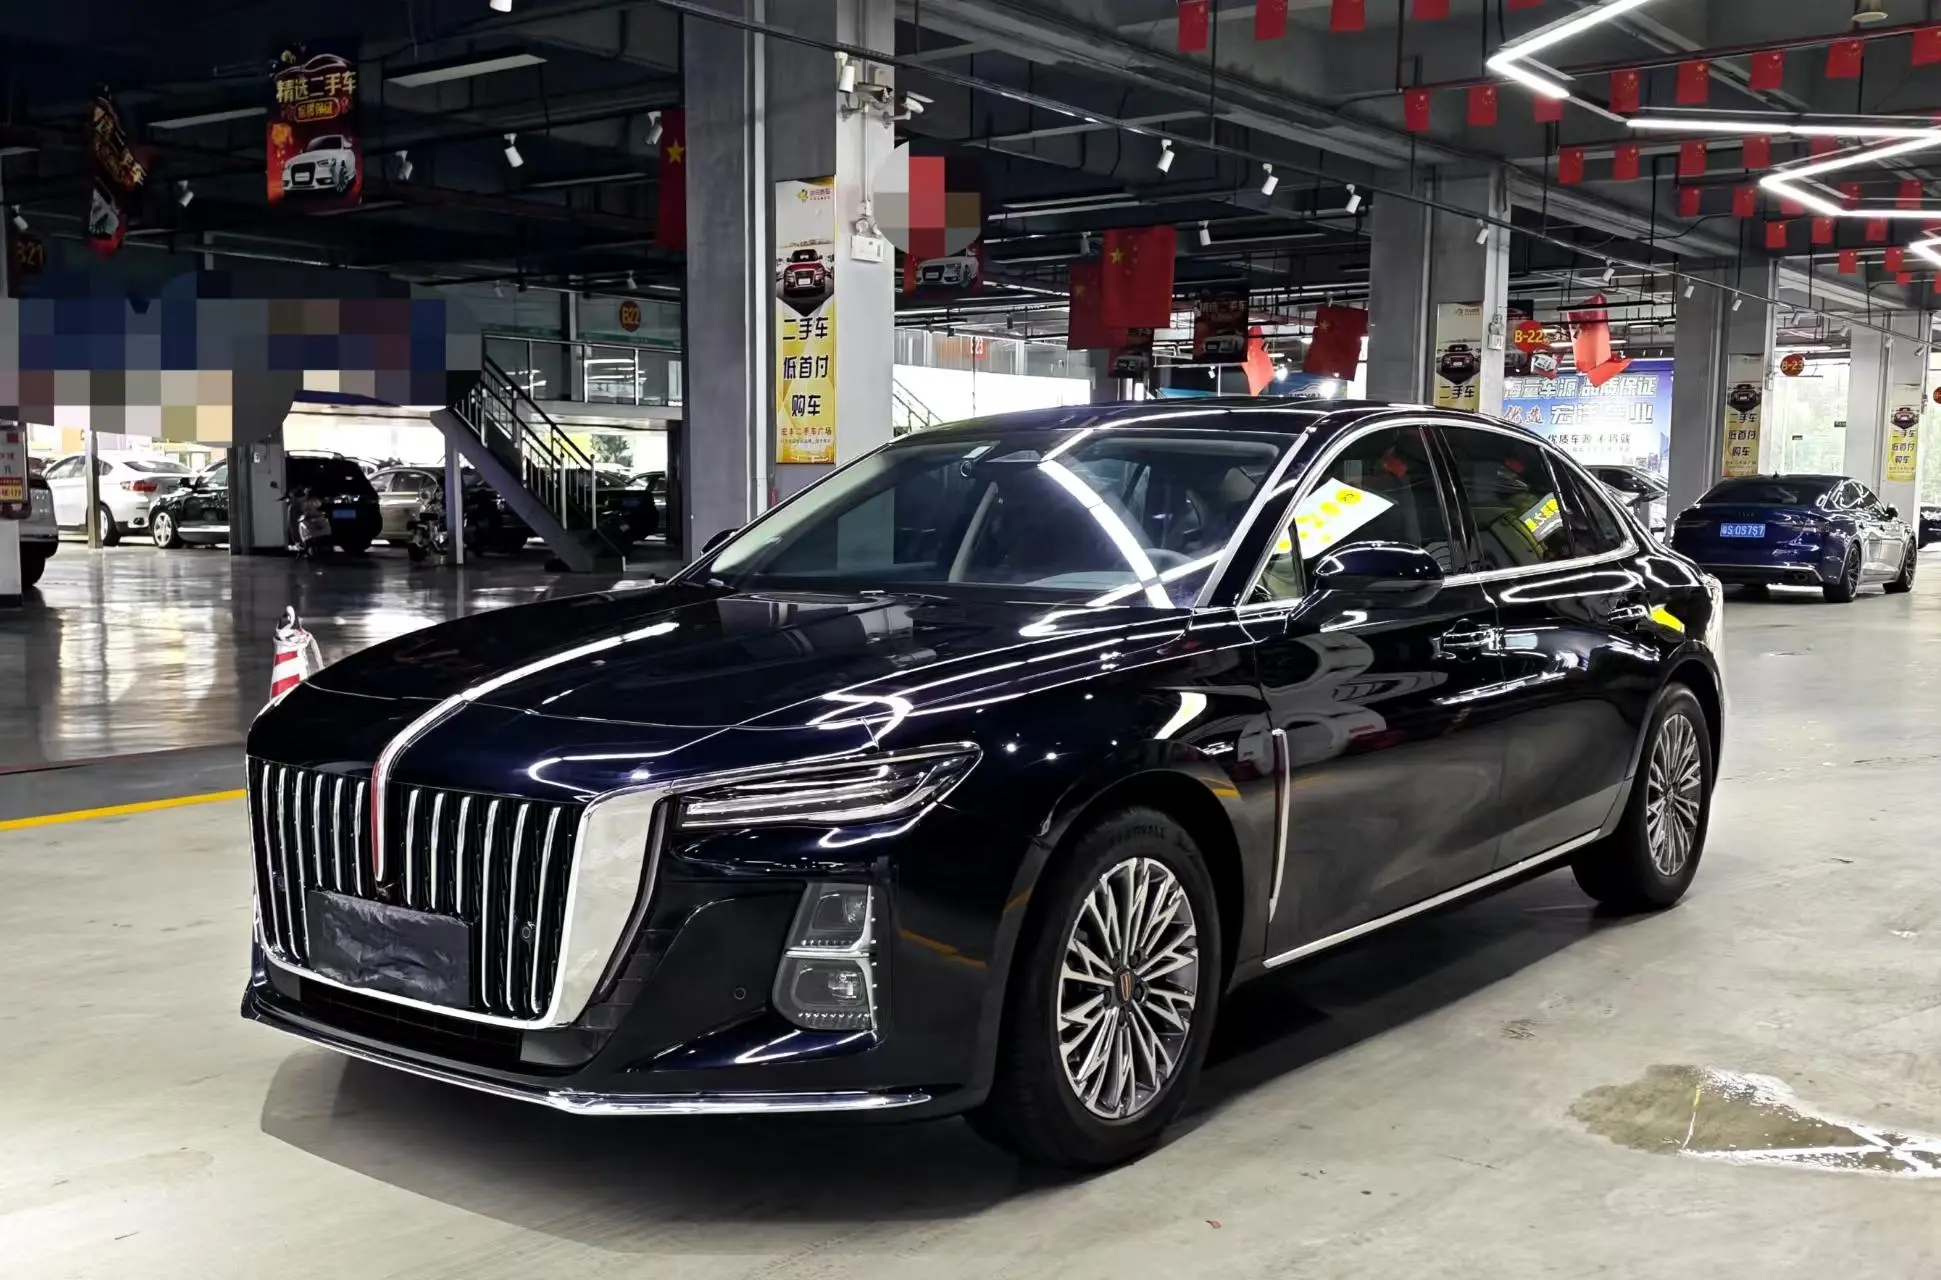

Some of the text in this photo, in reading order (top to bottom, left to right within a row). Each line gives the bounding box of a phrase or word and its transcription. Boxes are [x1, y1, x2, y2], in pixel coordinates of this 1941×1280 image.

[275, 70, 357, 104] 精选二手车
[621, 305, 640, 325] B22
[782, 316, 829, 341] 二手车
[1514, 329, 1543, 343] B-22
[783, 354, 830, 380] 低首付
[1439, 385, 1476, 399] 二手车
[1503, 375, 1658, 399] 海量车源 品质保证
[790, 394, 822, 417] 购车
[1728, 413, 1758, 424] 二手车
